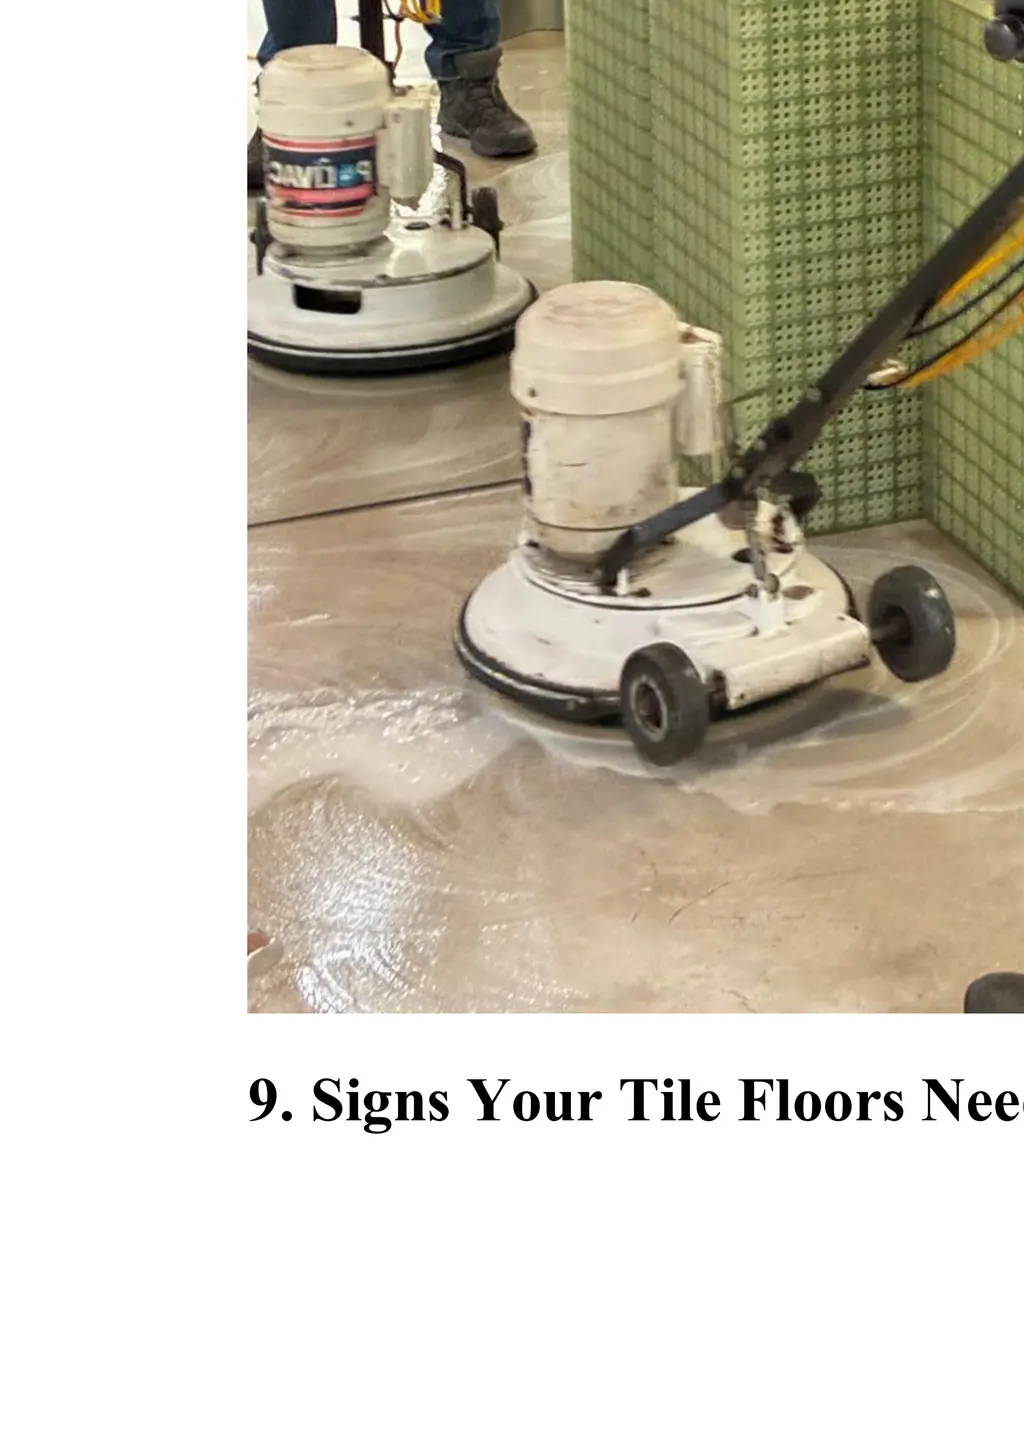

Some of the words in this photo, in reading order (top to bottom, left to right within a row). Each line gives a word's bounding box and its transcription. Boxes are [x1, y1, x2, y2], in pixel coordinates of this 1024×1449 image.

[250, 1078, 292, 1122] 9.
[313, 1078, 449, 1134] Signs
[467, 1079, 602, 1122] Your
[620, 1078, 720, 1122] Tile
[739, 1079, 903, 1122] Floors
